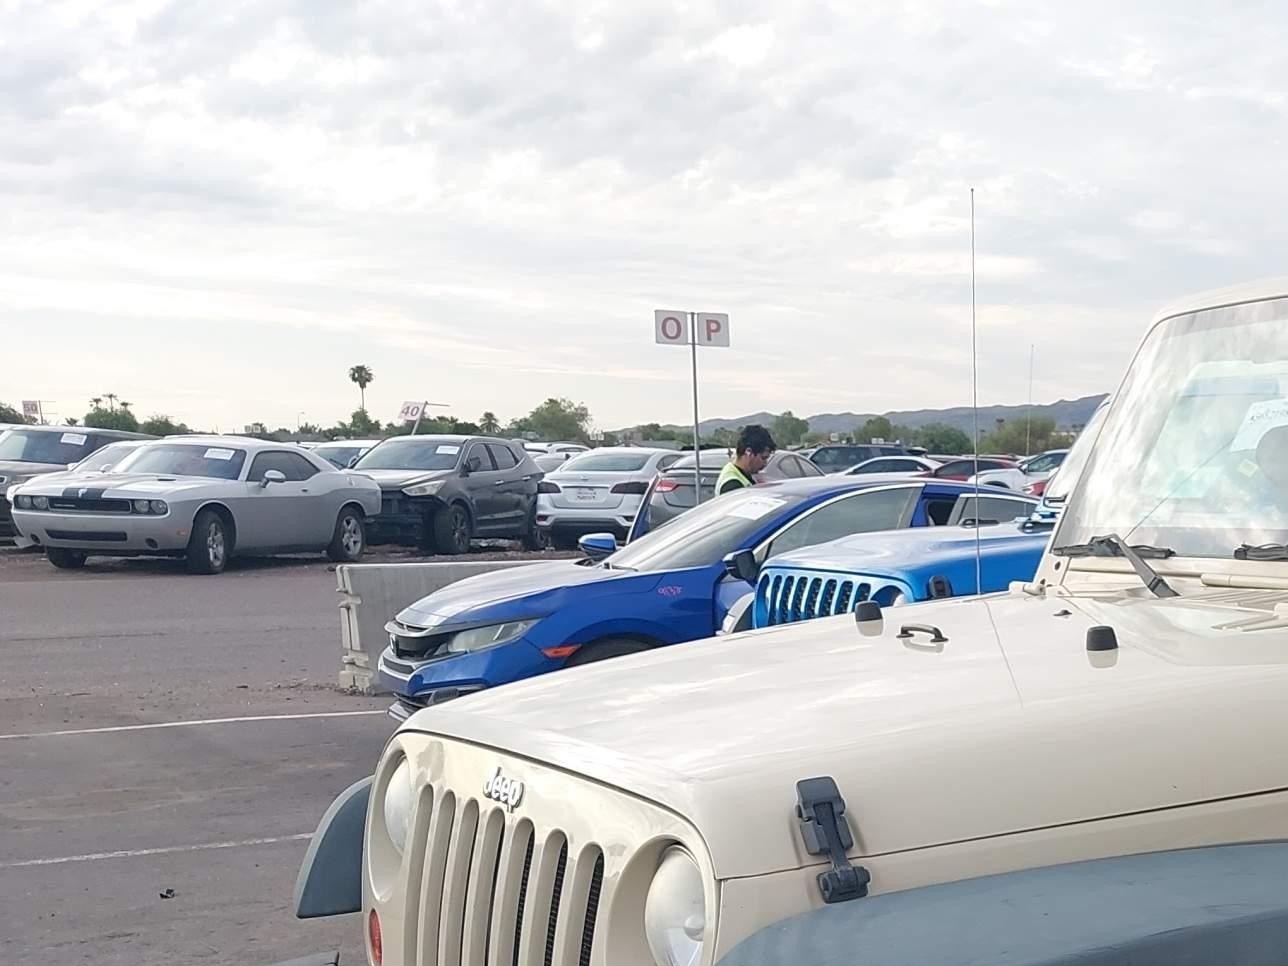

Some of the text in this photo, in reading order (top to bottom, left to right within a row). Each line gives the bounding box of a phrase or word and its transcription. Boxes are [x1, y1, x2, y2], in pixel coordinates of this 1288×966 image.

[661, 316, 682, 340] O
[705, 319, 722, 341] P
[401, 405, 420, 417] 40
[483, 767, 525, 814] Jeep
